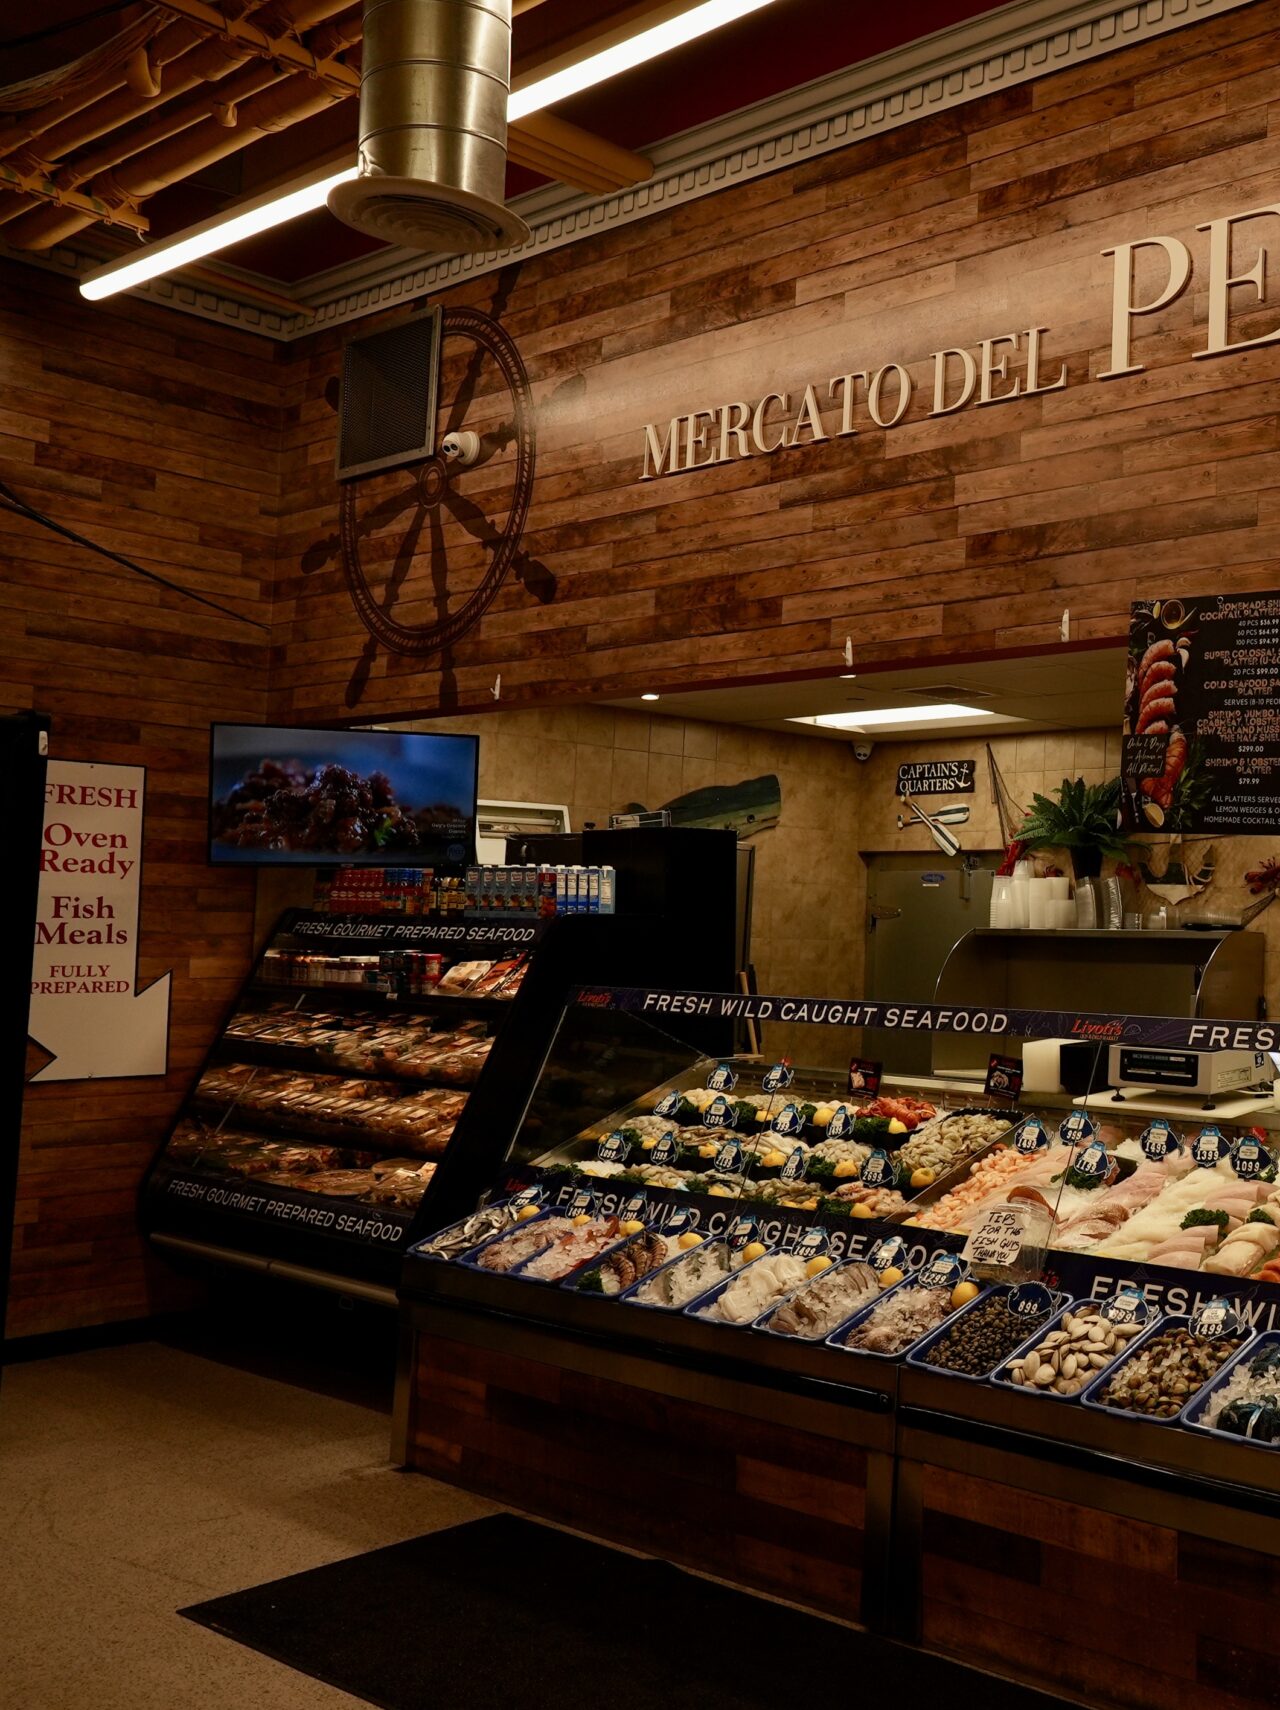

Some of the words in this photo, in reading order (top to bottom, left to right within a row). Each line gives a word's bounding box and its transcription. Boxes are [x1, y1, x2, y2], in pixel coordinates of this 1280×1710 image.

[639, 362, 911, 480] MERCATO
[928, 326, 1068, 418] DEL
[1200, 610, 1242, 621] COCKTAIL
[1204, 650, 1230, 660] SUPER
[1232, 648, 1275, 658] COLOSSAL
[1224, 656, 1258, 666] PLATTER
[1256, 667, 1279, 675] $99.00
[1203, 680, 1227, 690] COLD
[1228, 678, 1268, 688] SEAFOOD
[1238, 687, 1272, 696] PLATTER
[1244, 709, 1274, 718] JUMBO
[1196, 727, 1215, 736] NEW
[1217, 726, 1255, 735] ZEALAND
[1220, 734, 1238, 742] THE
[1240, 734, 1257, 742] HALF
[1238, 745, 1264, 753] $299.00
[1205, 758, 1239, 767] SHRIMP
[899, 762, 959, 779] CAPTAIN'S
[1236, 766, 1271, 774] PLATTER
[899, 778, 955, 793] QUARTERS
[45, 783, 138, 809] FRESH
[1224, 795, 1256, 803] PLATTERS
[1239, 806, 1266, 814] WEDGES
[1242, 816, 1276, 825] COCKTAIL
[44, 823, 129, 849] Oven
[40, 849, 134, 880] Ready
[51, 896, 115, 919] Fish
[35, 922, 128, 945] Meals
[293, 921, 331, 935] FRESH
[333, 923, 394, 938] GOURMET
[393, 925, 465, 940] PREPARED
[466, 926, 536, 941] SEAFOOD
[50, 965, 110, 978] FULLY
[30, 981, 129, 995] PREPARED
[643, 994, 713, 1016] FRESH
[720, 999, 773, 1019] WILD
[780, 1002, 878, 1026] CAUGHT
[884, 1008, 1008, 1033] SEAFOOD
[1072, 1019, 1124, 1036] Livoti's
[1146, 1142, 1167, 1154] 1499
[1196, 1150, 1219, 1160] 1399
[1236, 1160, 1260, 1172] 1099
[167, 1180, 205, 1199] FRESH
[207, 1188, 266, 1213] GOURMET
[265, 1200, 335, 1228] PREPARED
[336, 1215, 403, 1241] SEAFOOD
[990, 1212, 1016, 1225] TIPS
[978, 1225, 1002, 1235] FOR
[1004, 1227, 1024, 1236] THE
[971, 1236, 998, 1246] FISH
[1000, 1239, 1020, 1251] GUYS
[972, 1246, 995, 1258] THANK
[996, 1250, 1010, 1260] YOU
[922, 1272, 947, 1284] 1299
[1018, 1301, 1037, 1314] 899
[1194, 1323, 1223, 1335] 1499
